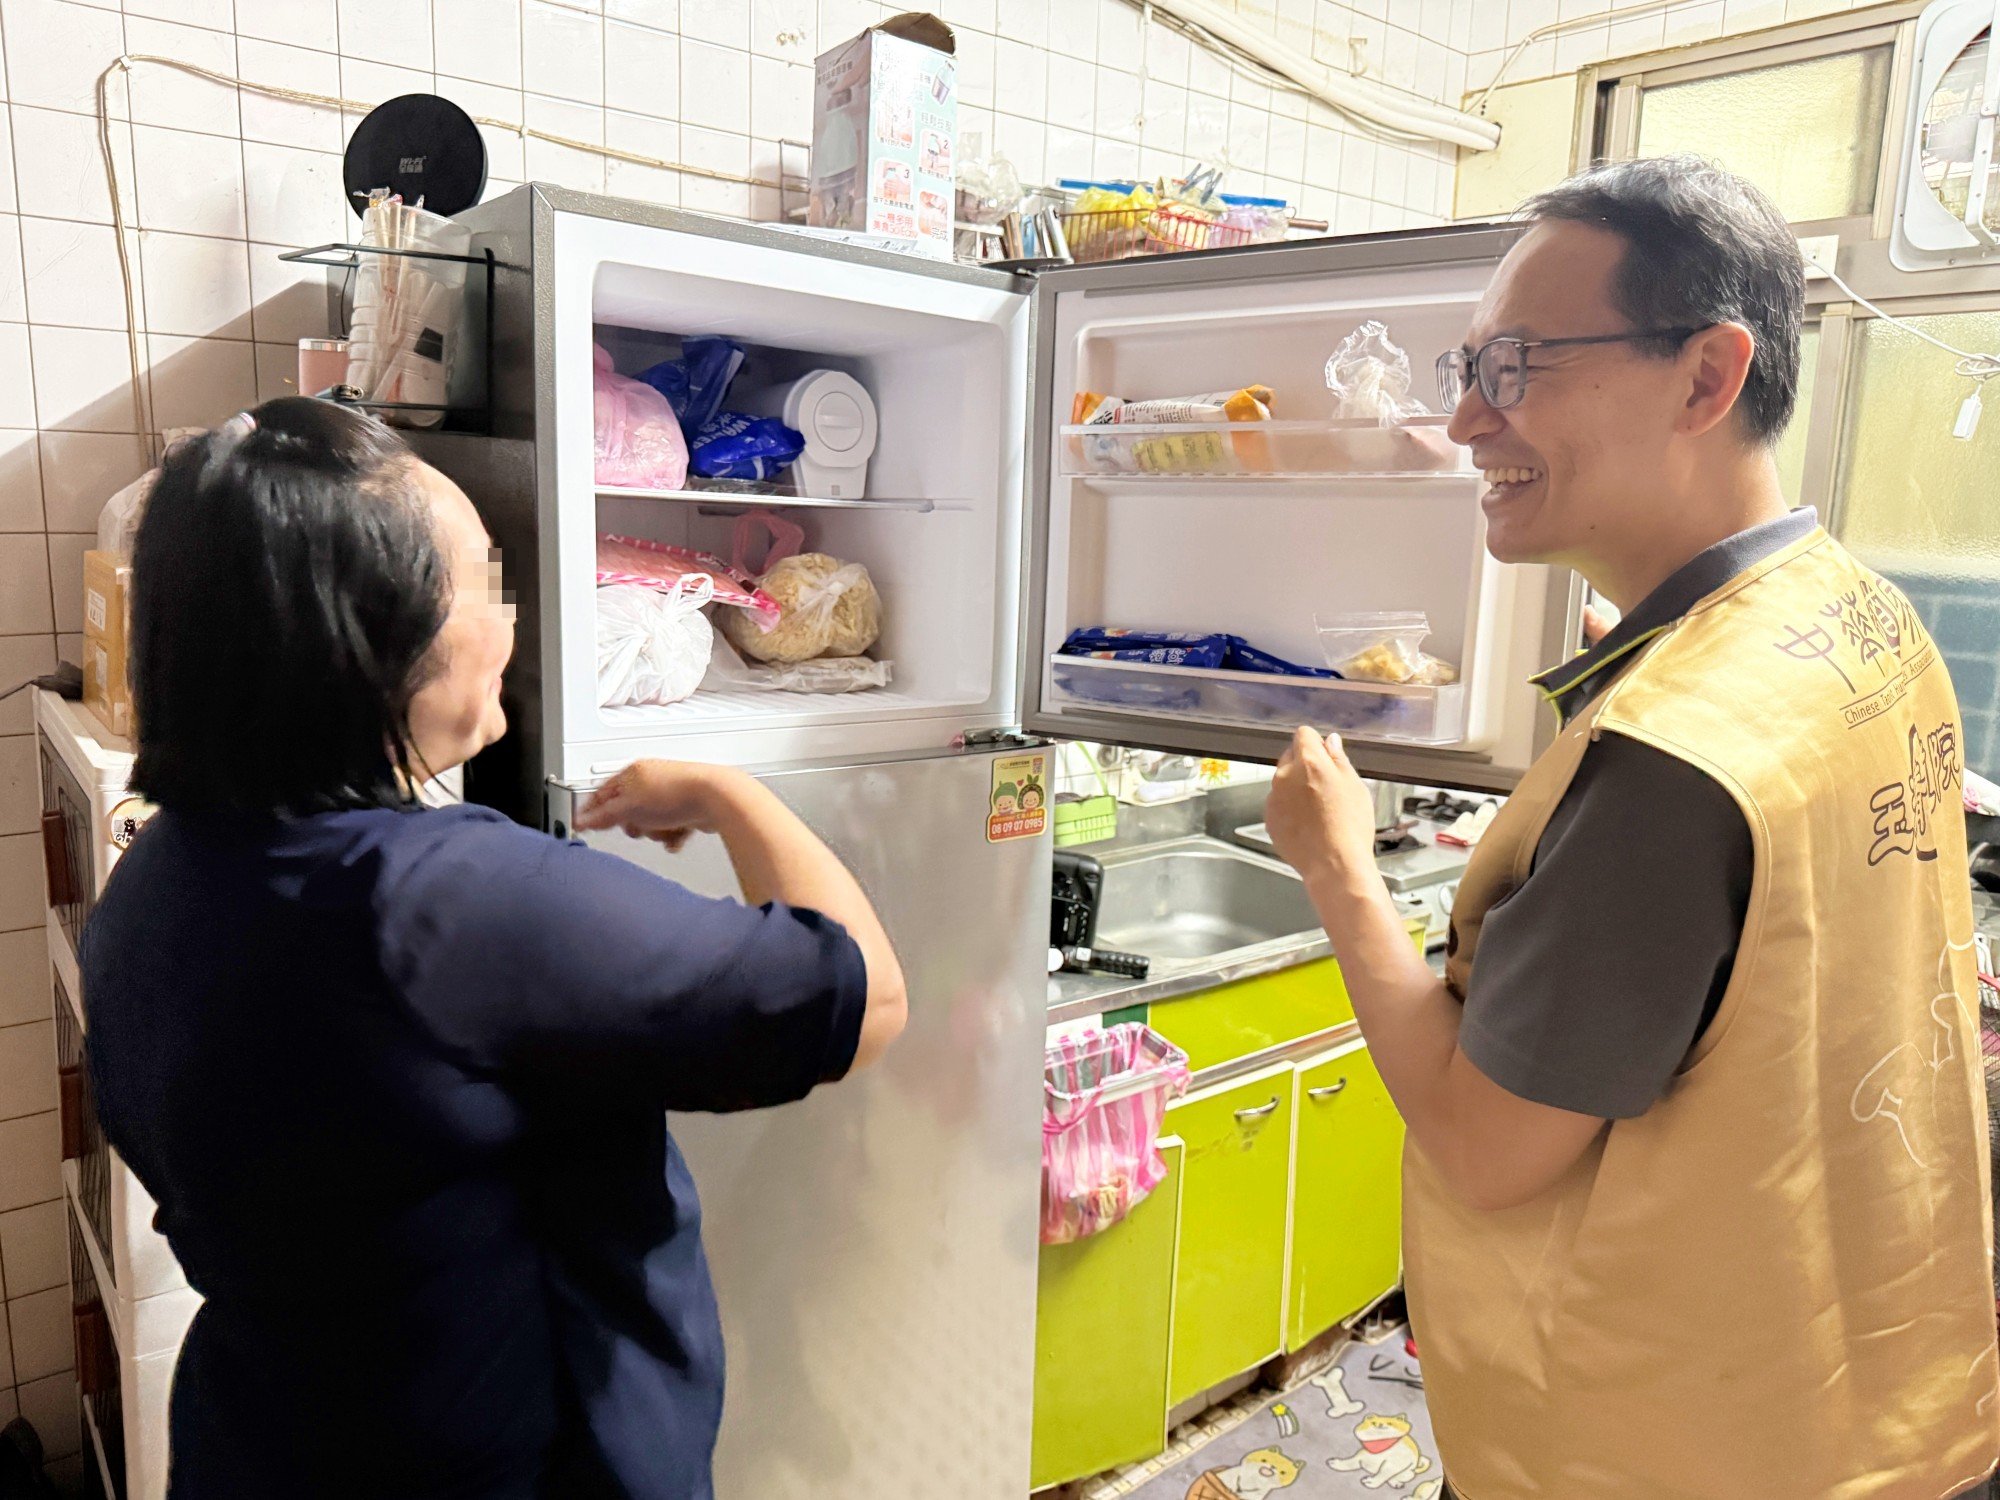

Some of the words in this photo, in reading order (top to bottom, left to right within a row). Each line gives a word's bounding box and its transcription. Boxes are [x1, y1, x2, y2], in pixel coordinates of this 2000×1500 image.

[904, 169, 910, 179] 3
[1844, 701, 1880, 724] Chinese
[1002, 821, 1013, 833] 09
[1013, 820, 1023, 831] 07
[1024, 817, 1043, 830] 0985
